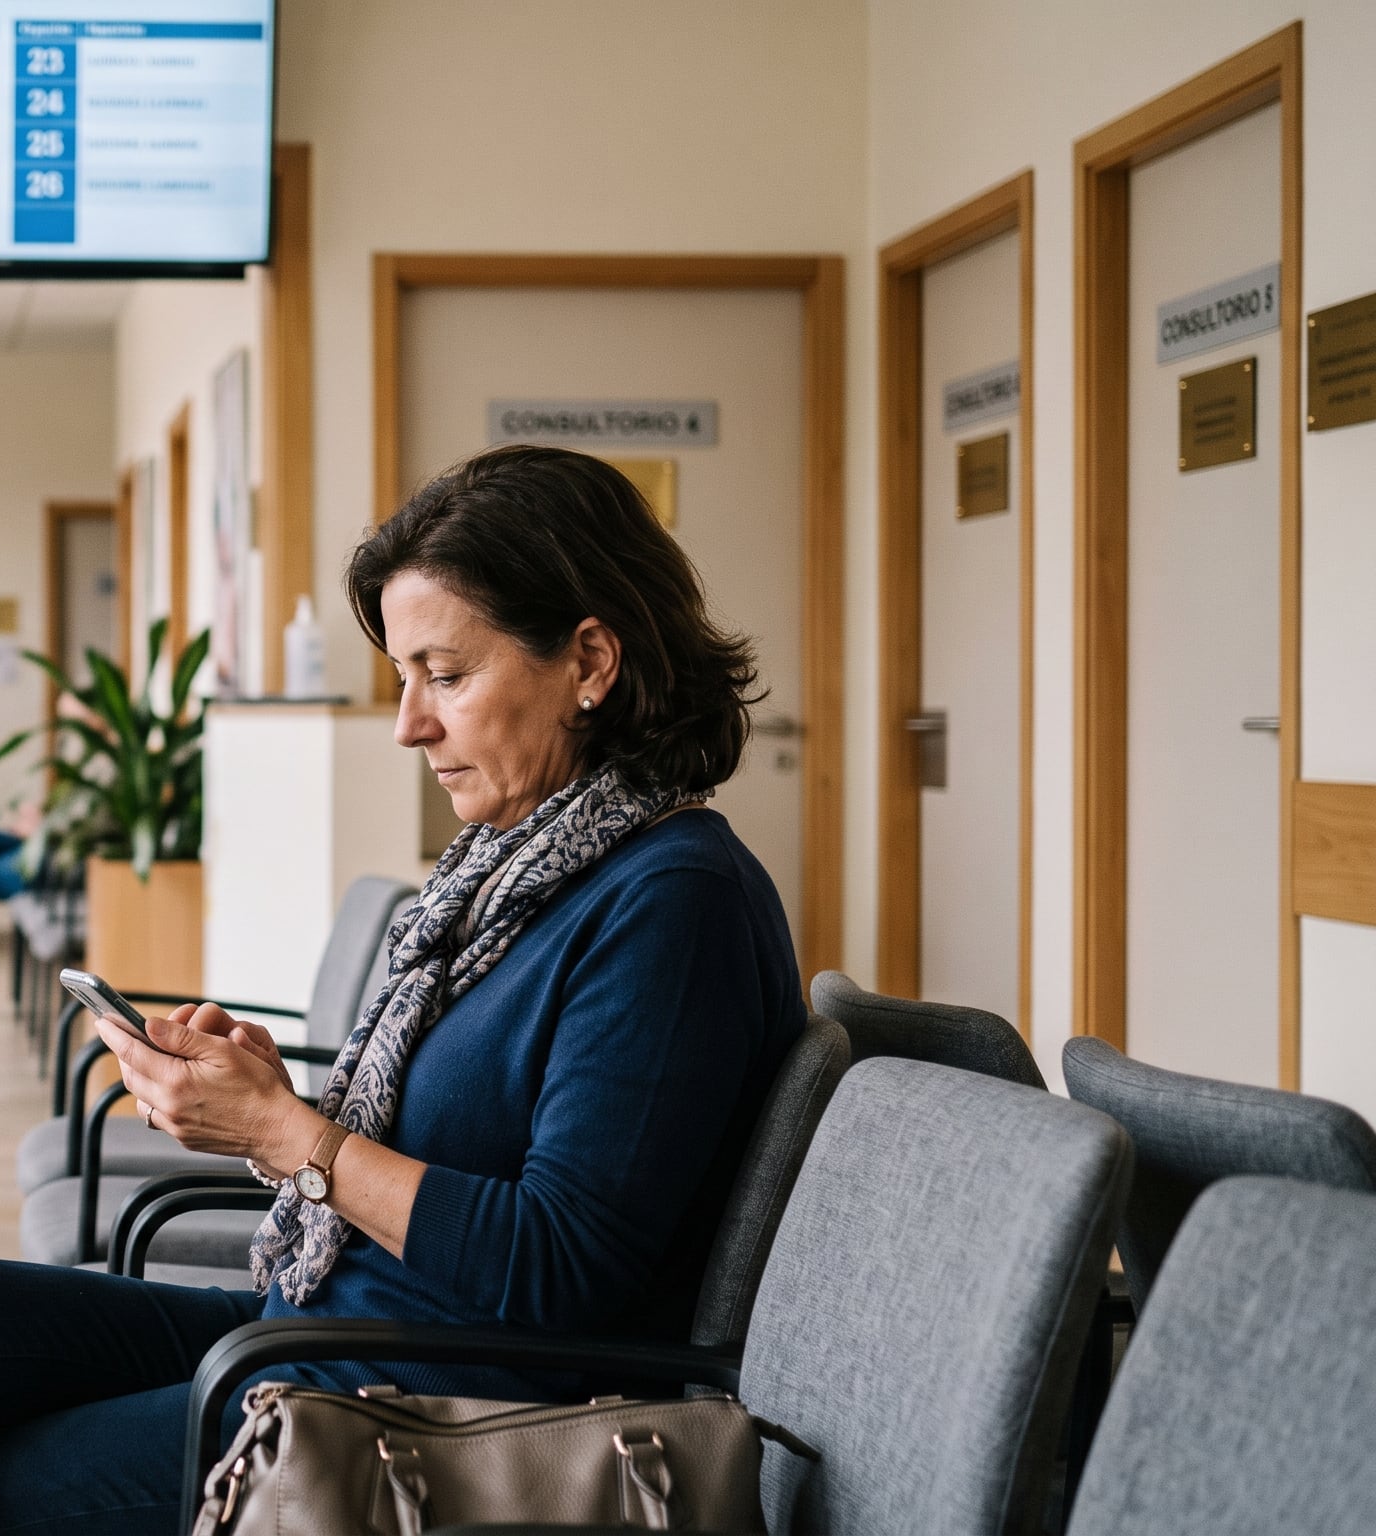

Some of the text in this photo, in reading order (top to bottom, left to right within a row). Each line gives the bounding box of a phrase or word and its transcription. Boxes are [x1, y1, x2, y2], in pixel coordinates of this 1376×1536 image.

[26, 47, 64, 75] 23
[26, 88, 64, 116] 24
[1161, 289, 1261, 347] CONSULTORIO
[500, 409, 680, 437] CONSULTORIO
